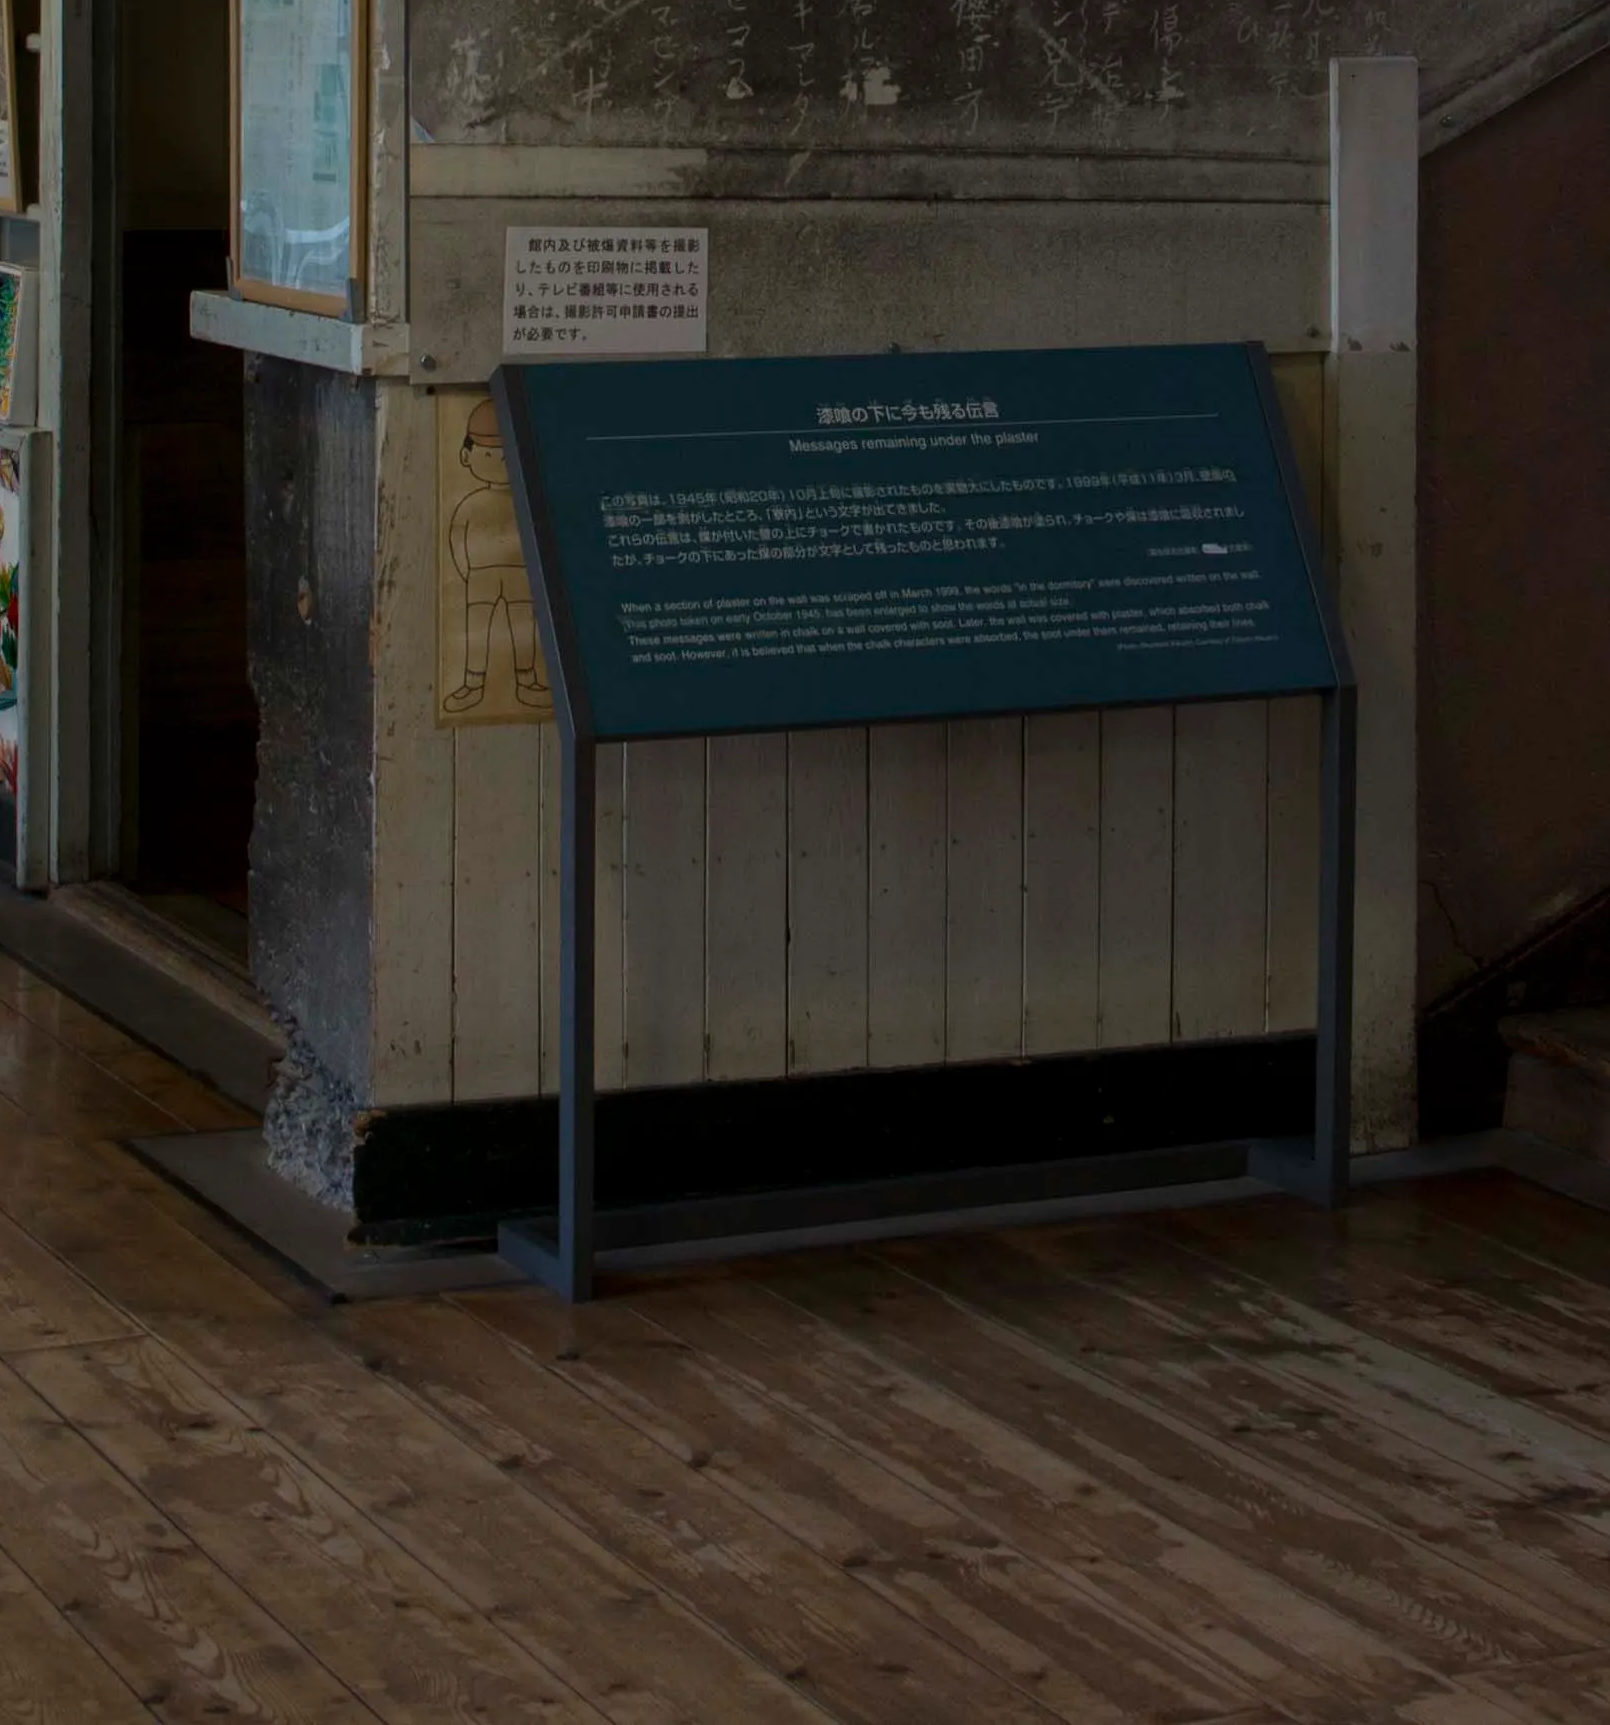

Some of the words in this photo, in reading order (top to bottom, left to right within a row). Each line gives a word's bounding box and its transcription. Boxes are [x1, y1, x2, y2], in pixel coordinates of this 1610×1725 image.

[528, 238, 701, 253] 館内及び被爆資料等を撮影
[516, 261, 699, 276] したものを印刷物に掲載した
[515, 282, 699, 298] り、テレビ番組等に使用される
[512, 305, 699, 320] 場合は、撮影許可申請書の提出
[512, 327, 587, 342] が必要です。
[789, 437, 858, 454] Messages
[862, 435, 926, 451] remaining
[930, 433, 967, 446] under
[971, 432, 991, 445] the
[995, 431, 1039, 445] plaster
[621, 601, 651, 613] When
[663, 599, 700, 610] section
[715, 596, 750, 610] plaster
[767, 594, 785, 605] the
[787, 593, 808, 604] wall
[809, 594, 830, 603] was
[901, 586, 932, 598] March
[963, 583, 980, 594] the
[983, 582, 1012, 593] words
[1029, 580, 1045, 591] the
[1097, 578, 1121, 587] were
[1123, 573, 1173, 586] discovered
[1175, 571, 1206, 583] written
[1223, 570, 1238, 580] the
[627, 633, 660, 645] These
[663, 632, 715, 645] messages
[717, 631, 741, 640] were
[745, 627, 778, 639] written
[793, 625, 819, 636] chalk
[845, 622, 865, 633] wall
[867, 620, 907, 632] covered
[909, 619, 929, 630] with
[989, 615, 1004, 625] the
[1007, 613, 1026, 624] wall
[1029, 614, 1047, 623] was
[1049, 610, 1088, 622] covered
[1089, 609, 1110, 620] with
[1149, 605, 1176, 617] which
[1221, 602, 1243, 613] both
[1245, 600, 1270, 612] chalk
[649, 616, 677, 629] photo
[679, 615, 708, 626] taken
[725, 612, 750, 626] early
[753, 610, 792, 622] October
[825, 608, 844, 619] has
[845, 607, 871, 618] been
[873, 604, 916, 618] enlarged
[931, 602, 956, 614] show
[957, 601, 974, 612] the
[975, 600, 1005, 611] words
[1019, 598, 1047, 609] actual
[631, 652, 652, 663] and
[681, 647, 729, 660] However,
[751, 643, 794, 656] believed
[795, 642, 816, 653] that
[817, 641, 845, 652] when
[847, 640, 862, 650] the
[865, 638, 891, 649] chalk
[893, 635, 945, 648] characters
[947, 635, 971, 645] were
[1023, 629, 1038, 640] the
[1063, 626, 1090, 638] under
[1093, 625, 1117, 636] them
[1119, 622, 1166, 635] remained,
